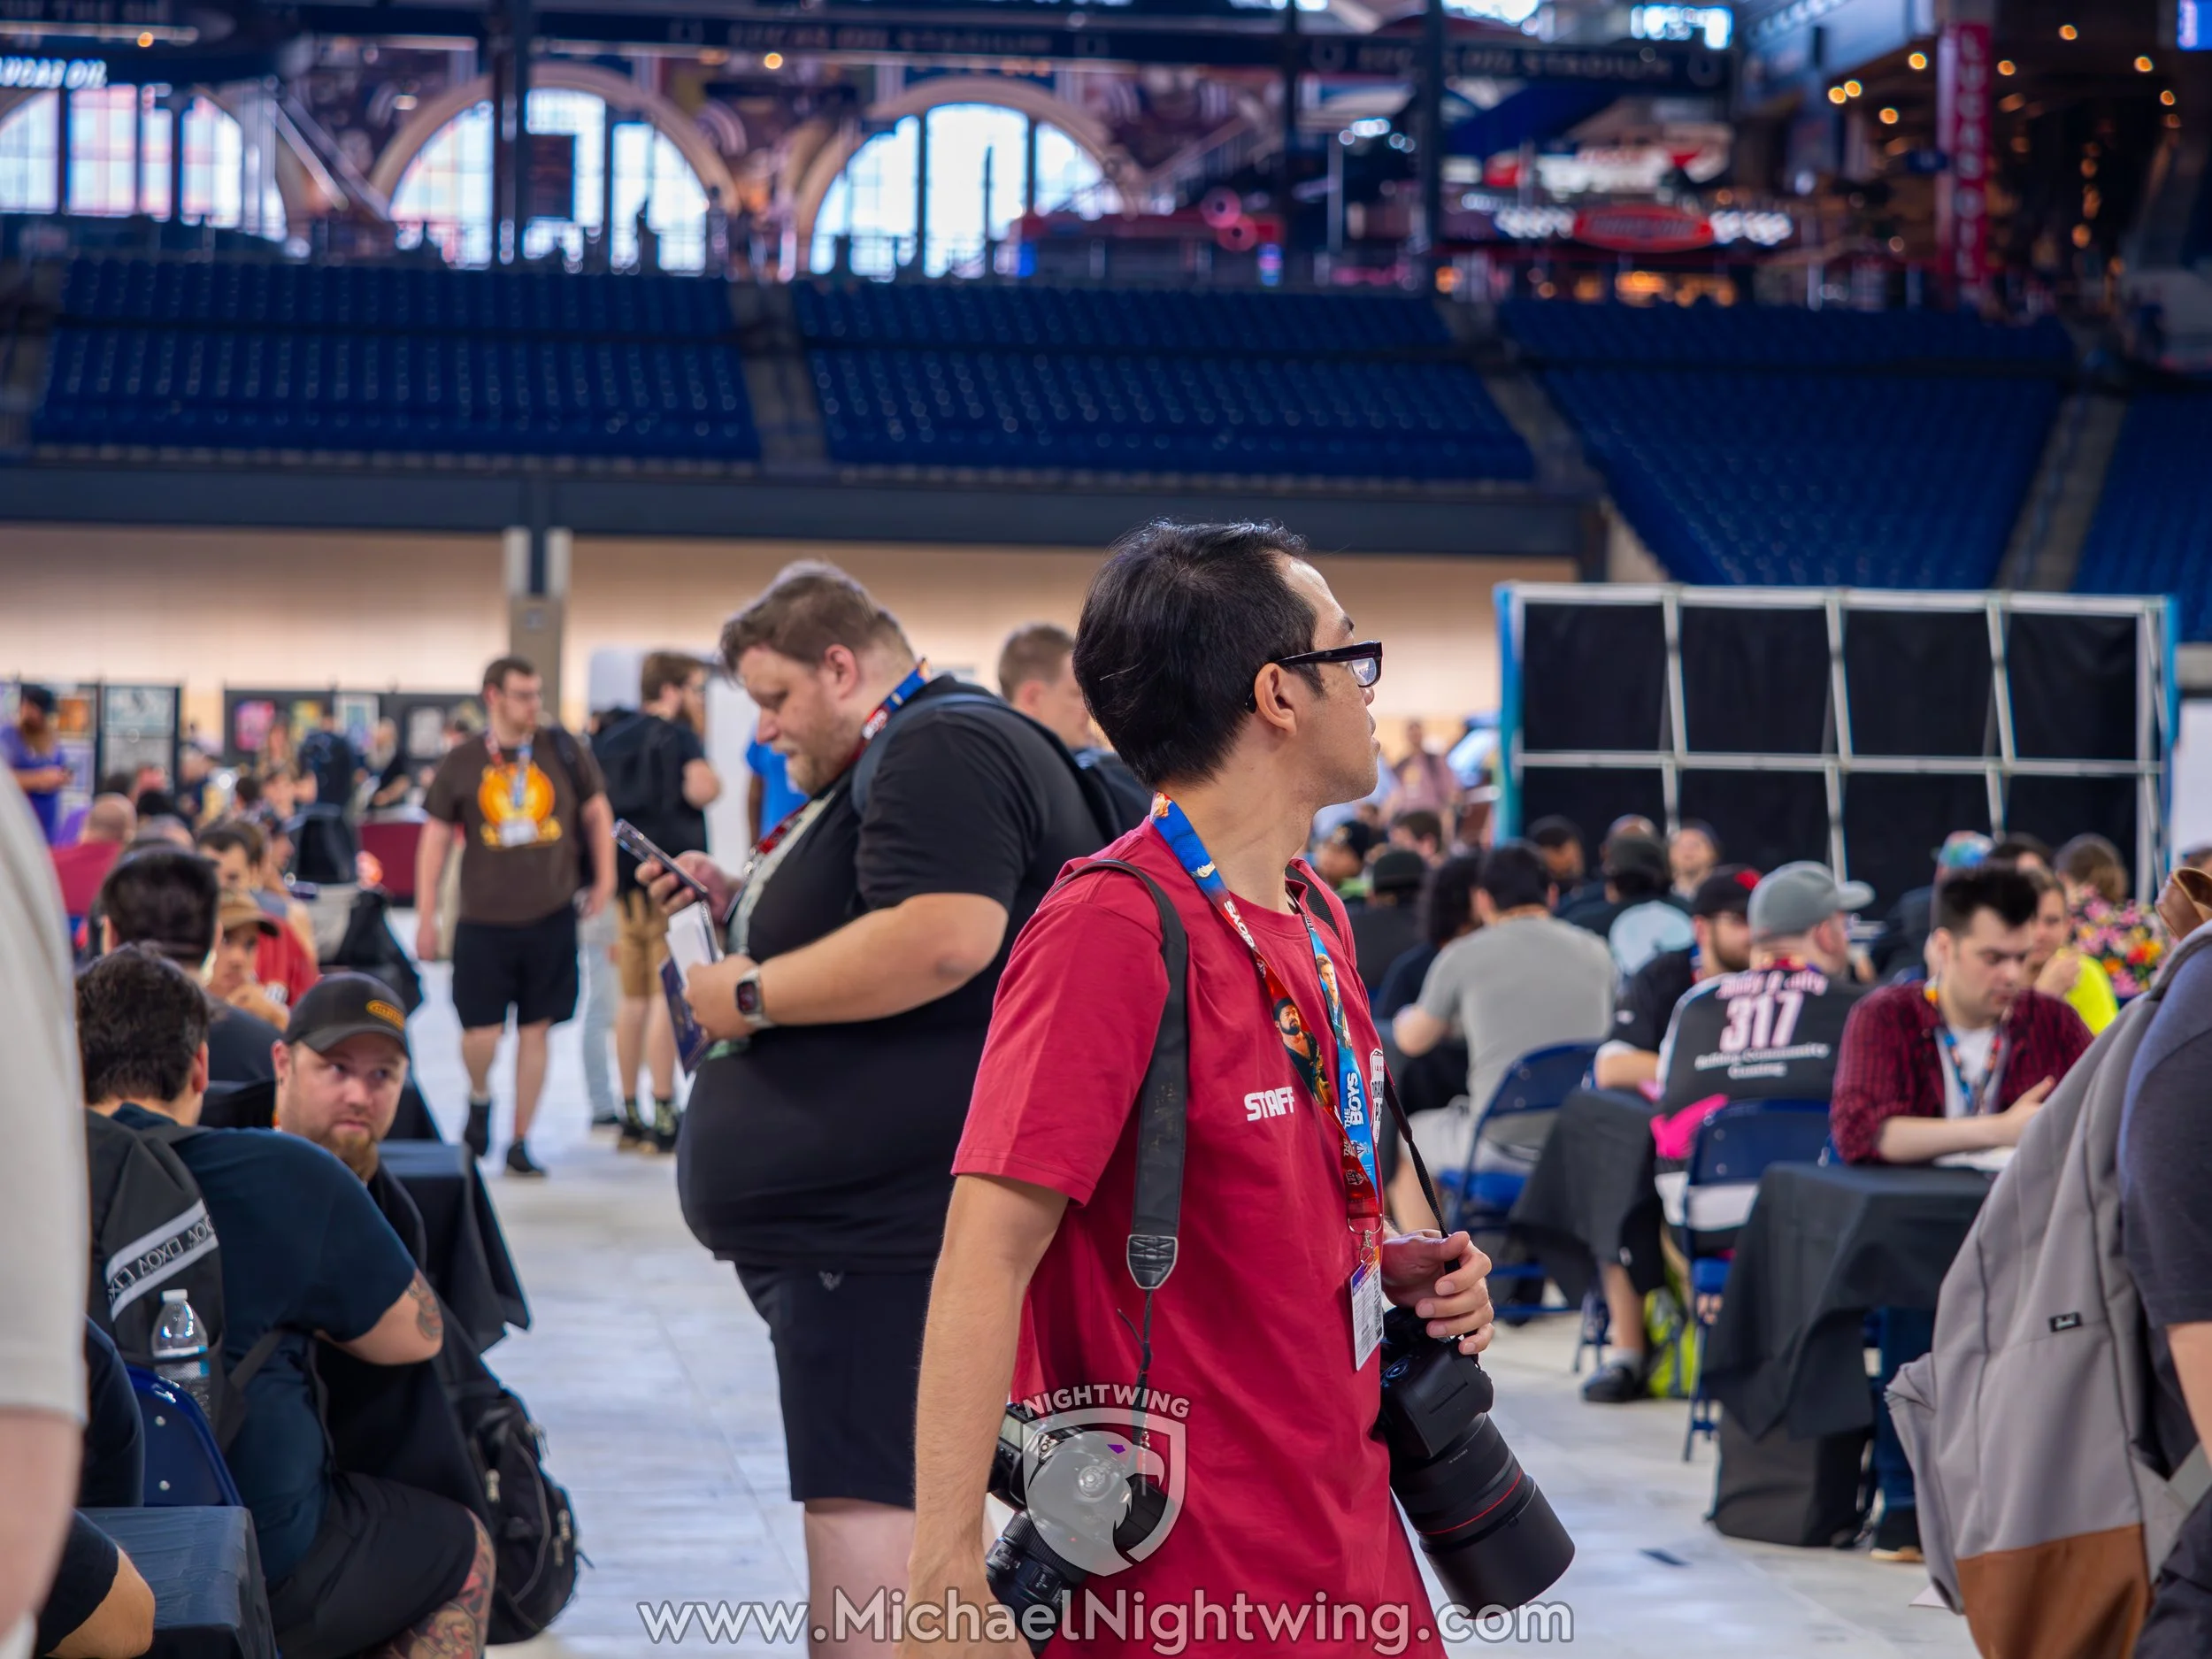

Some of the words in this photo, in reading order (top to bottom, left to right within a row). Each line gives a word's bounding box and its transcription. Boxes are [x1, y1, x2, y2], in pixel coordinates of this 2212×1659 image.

[1719, 988, 1805, 1052] 317
[1243, 1086, 1295, 1122] STAFF
[1347, 1071, 1364, 1125] BOYS
